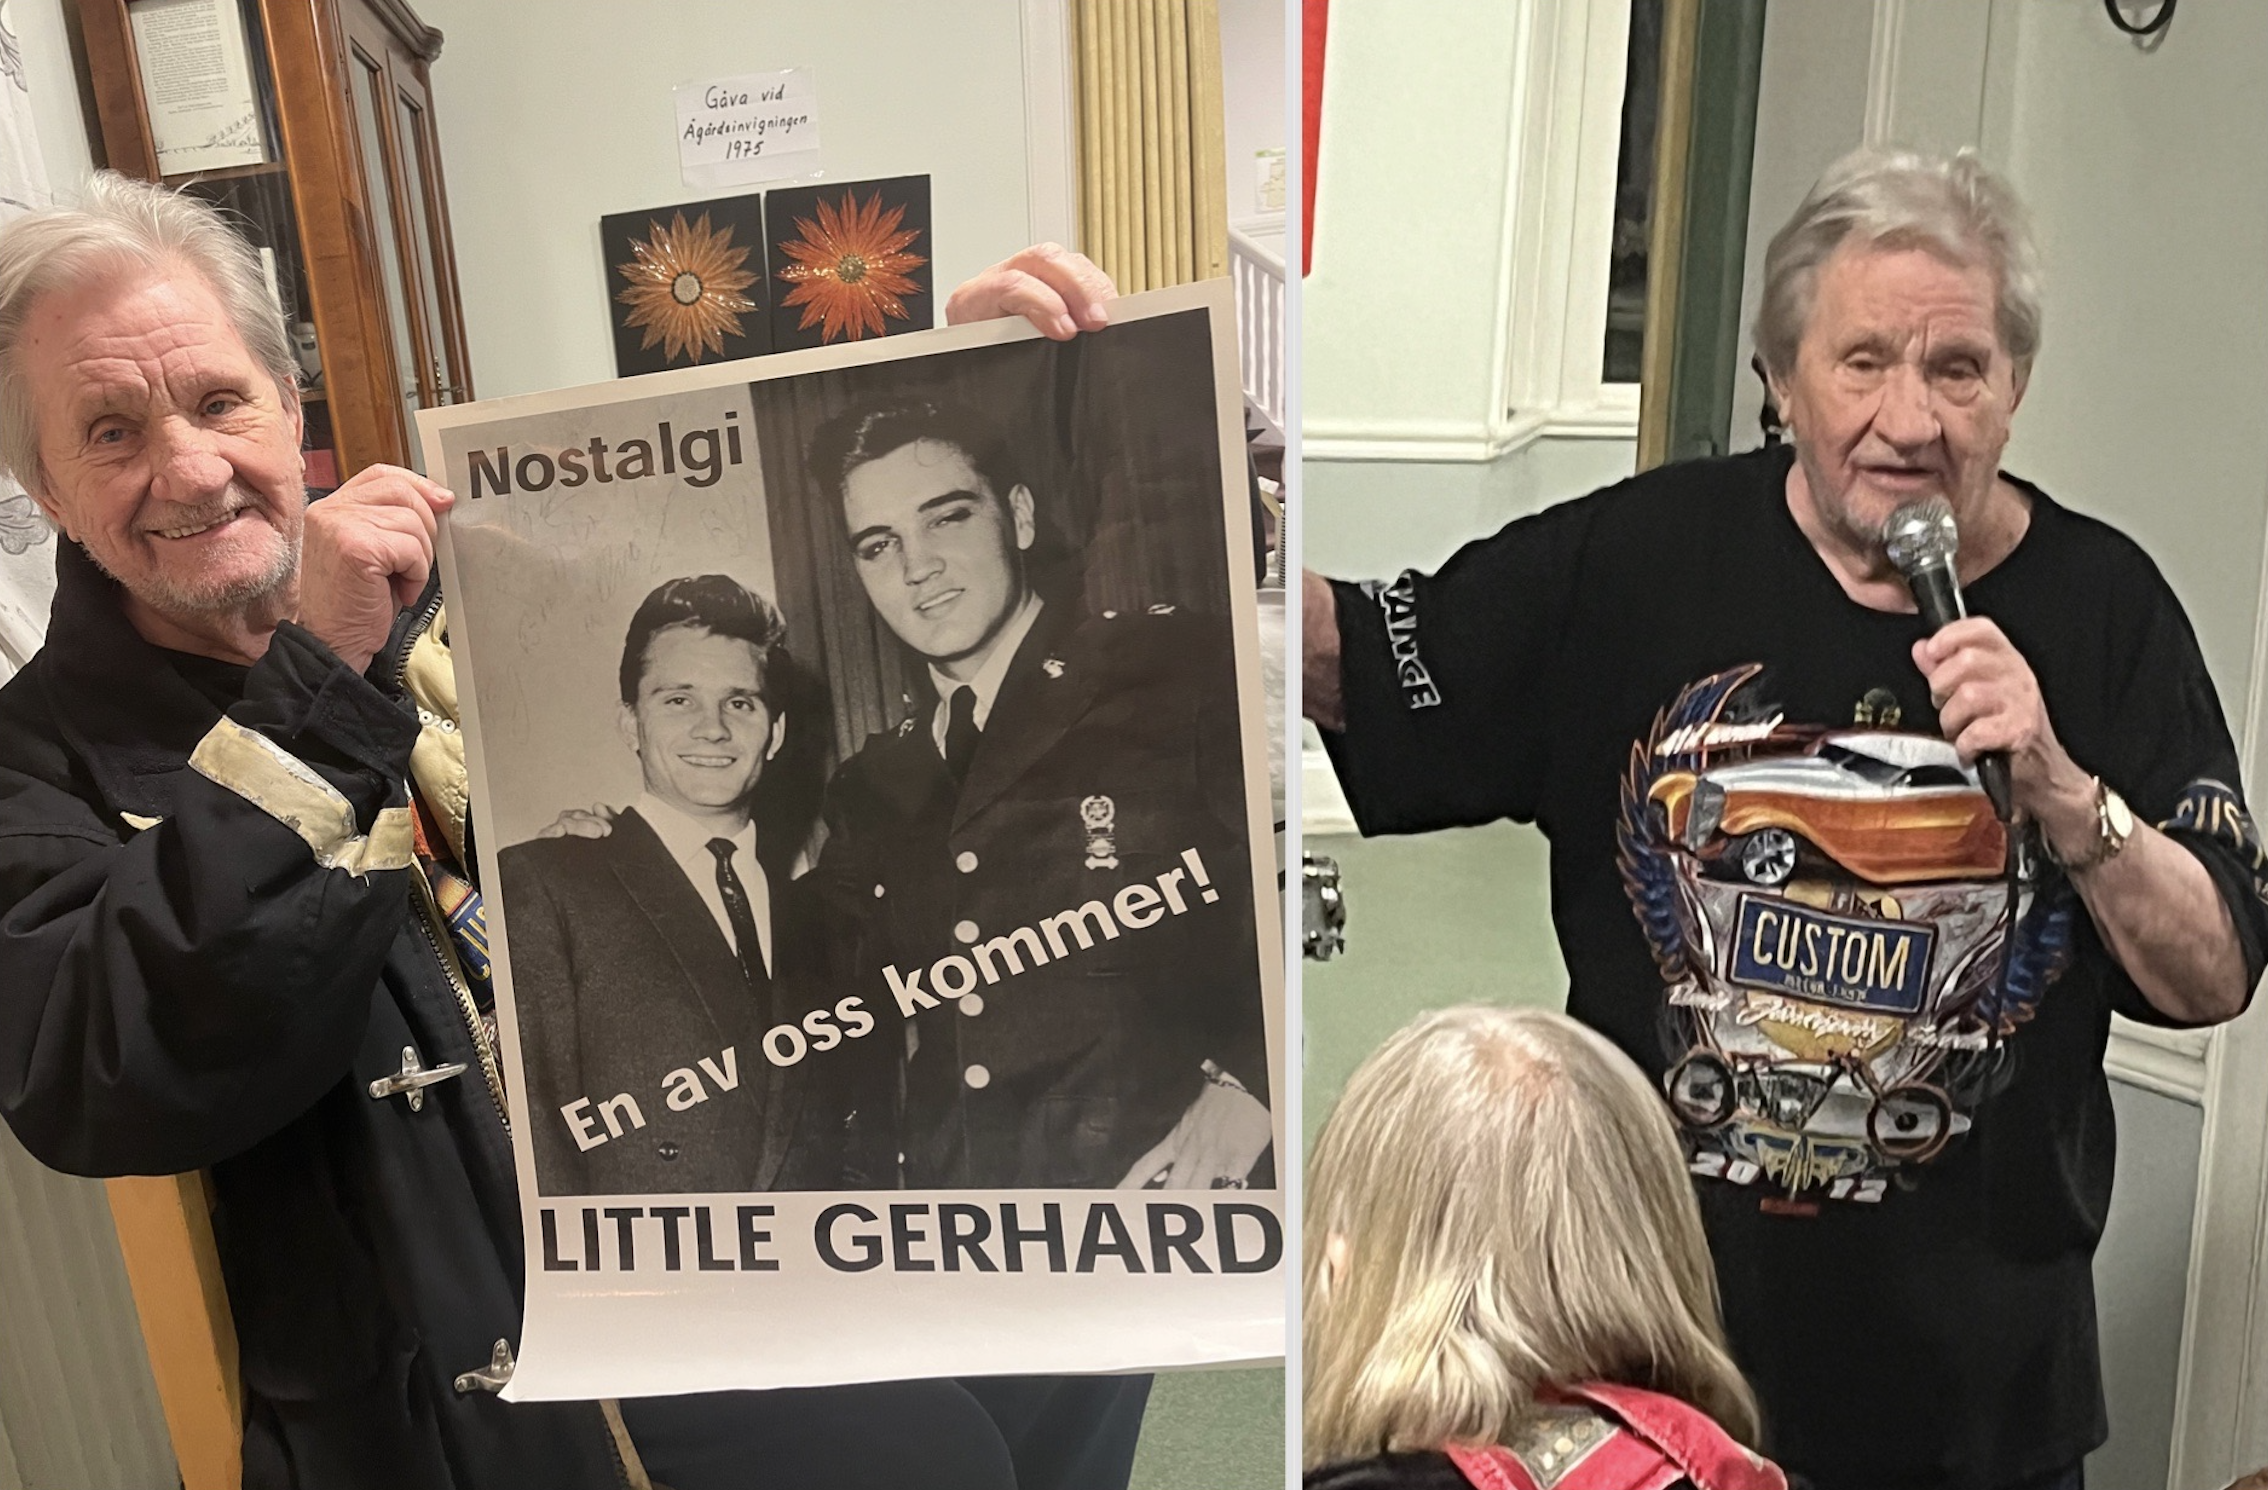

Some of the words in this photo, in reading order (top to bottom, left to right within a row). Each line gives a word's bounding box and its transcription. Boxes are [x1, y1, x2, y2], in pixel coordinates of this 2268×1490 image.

[704, 85, 748, 110] Gåva
[761, 83, 785, 102] vid
[725, 140, 765, 160] 1975
[467, 411, 742, 499] Nostalgi
[1753, 910, 1911, 991] CUSTOM
[560, 1092, 646, 1152] En
[661, 1046, 739, 1112] av
[762, 996, 875, 1067] oss
[882, 847, 1220, 1018] kommer!
[540, 1205, 780, 1271] LITTLE
[814, 1203, 1284, 1273] GERHARD
